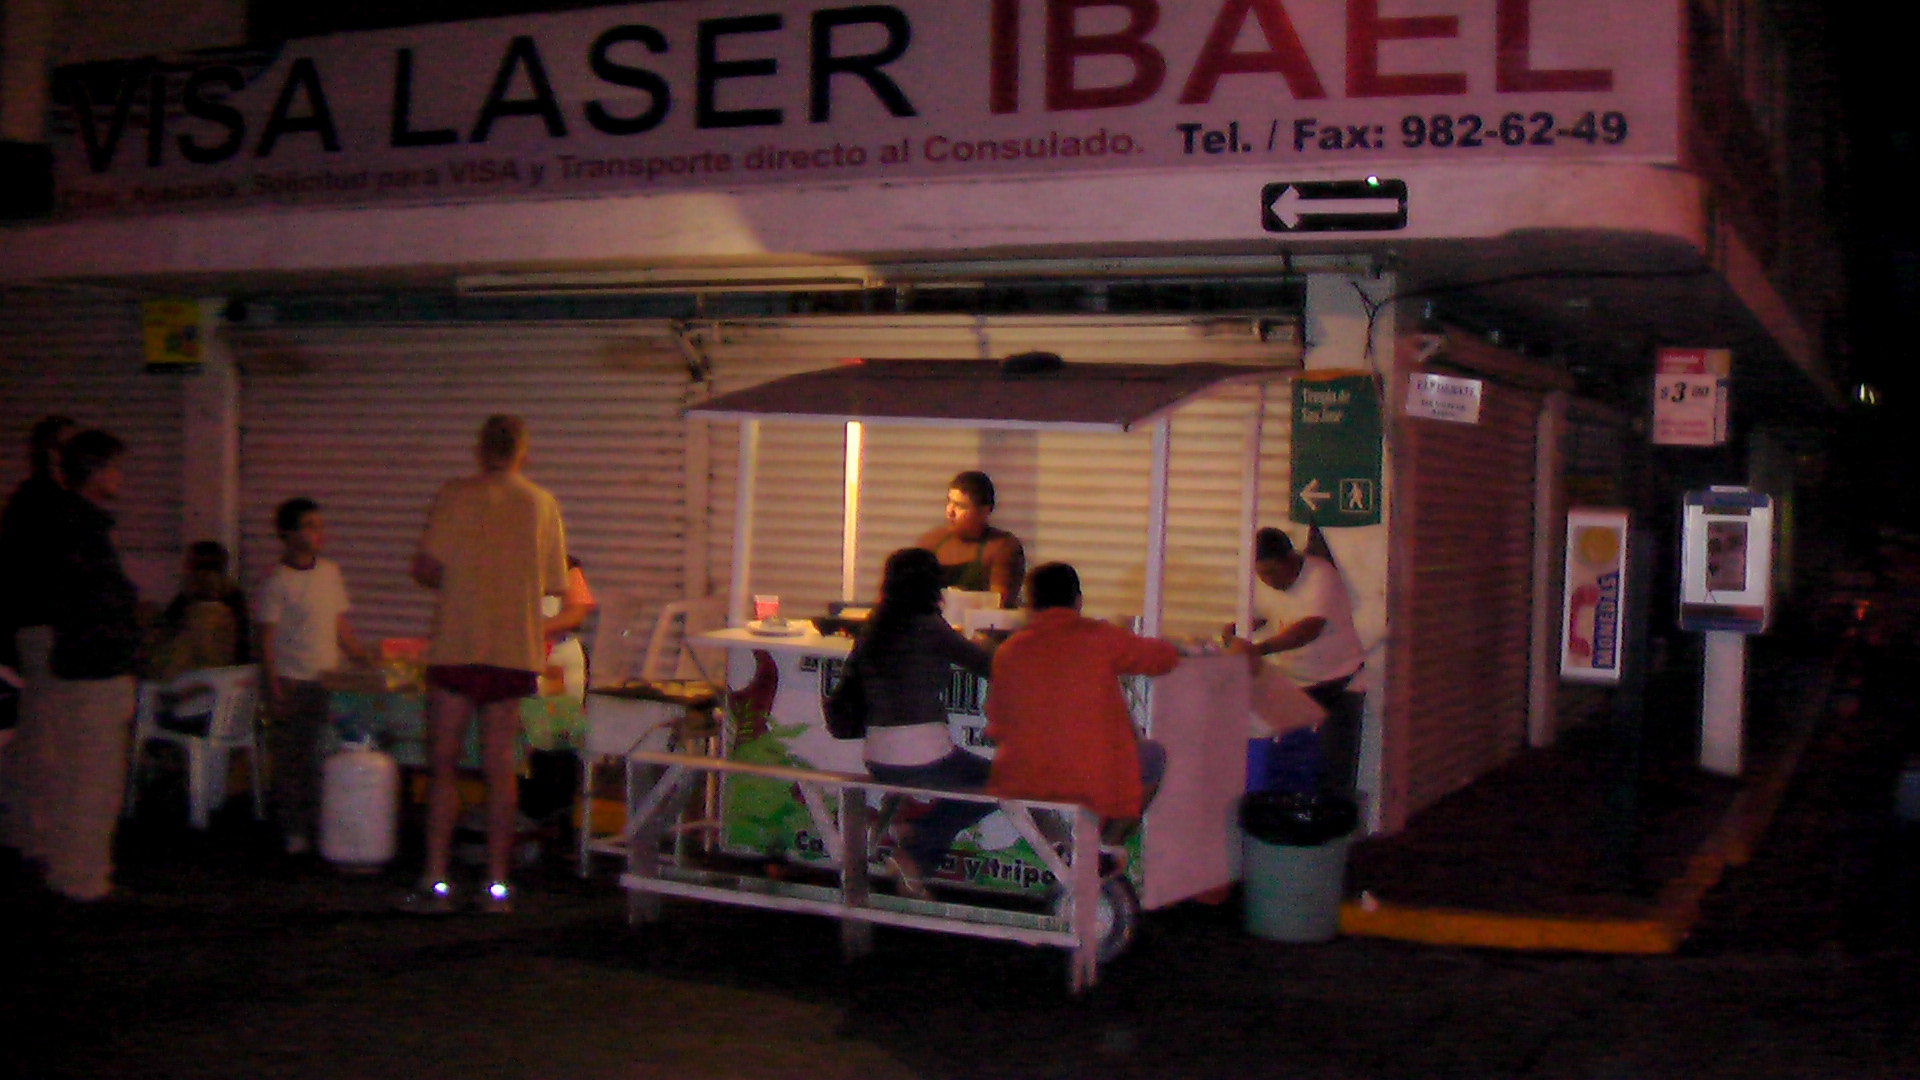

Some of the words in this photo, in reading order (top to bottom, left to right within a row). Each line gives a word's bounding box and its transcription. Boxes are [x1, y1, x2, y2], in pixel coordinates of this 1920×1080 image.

[66, 58, 341, 172] VISA
[390, 6, 917, 147] LASER
[990, 0, 1614, 115] IBAEL
[252, 168, 368, 196] Solicitud
[377, 167, 439, 194] para
[448, 157, 519, 185] VISA
[529, 161, 544, 185] y
[557, 150, 732, 181] Transporte
[744, 143, 867, 171] directo
[880, 138, 909, 164] al
[924, 128, 1145, 162] Consulado.
[1176, 121, 1252, 155] Tel.
[1266, 119, 1279, 152] /
[1292, 118, 1385, 151] Fax:
[1401, 111, 1629, 150] 982-62-49
